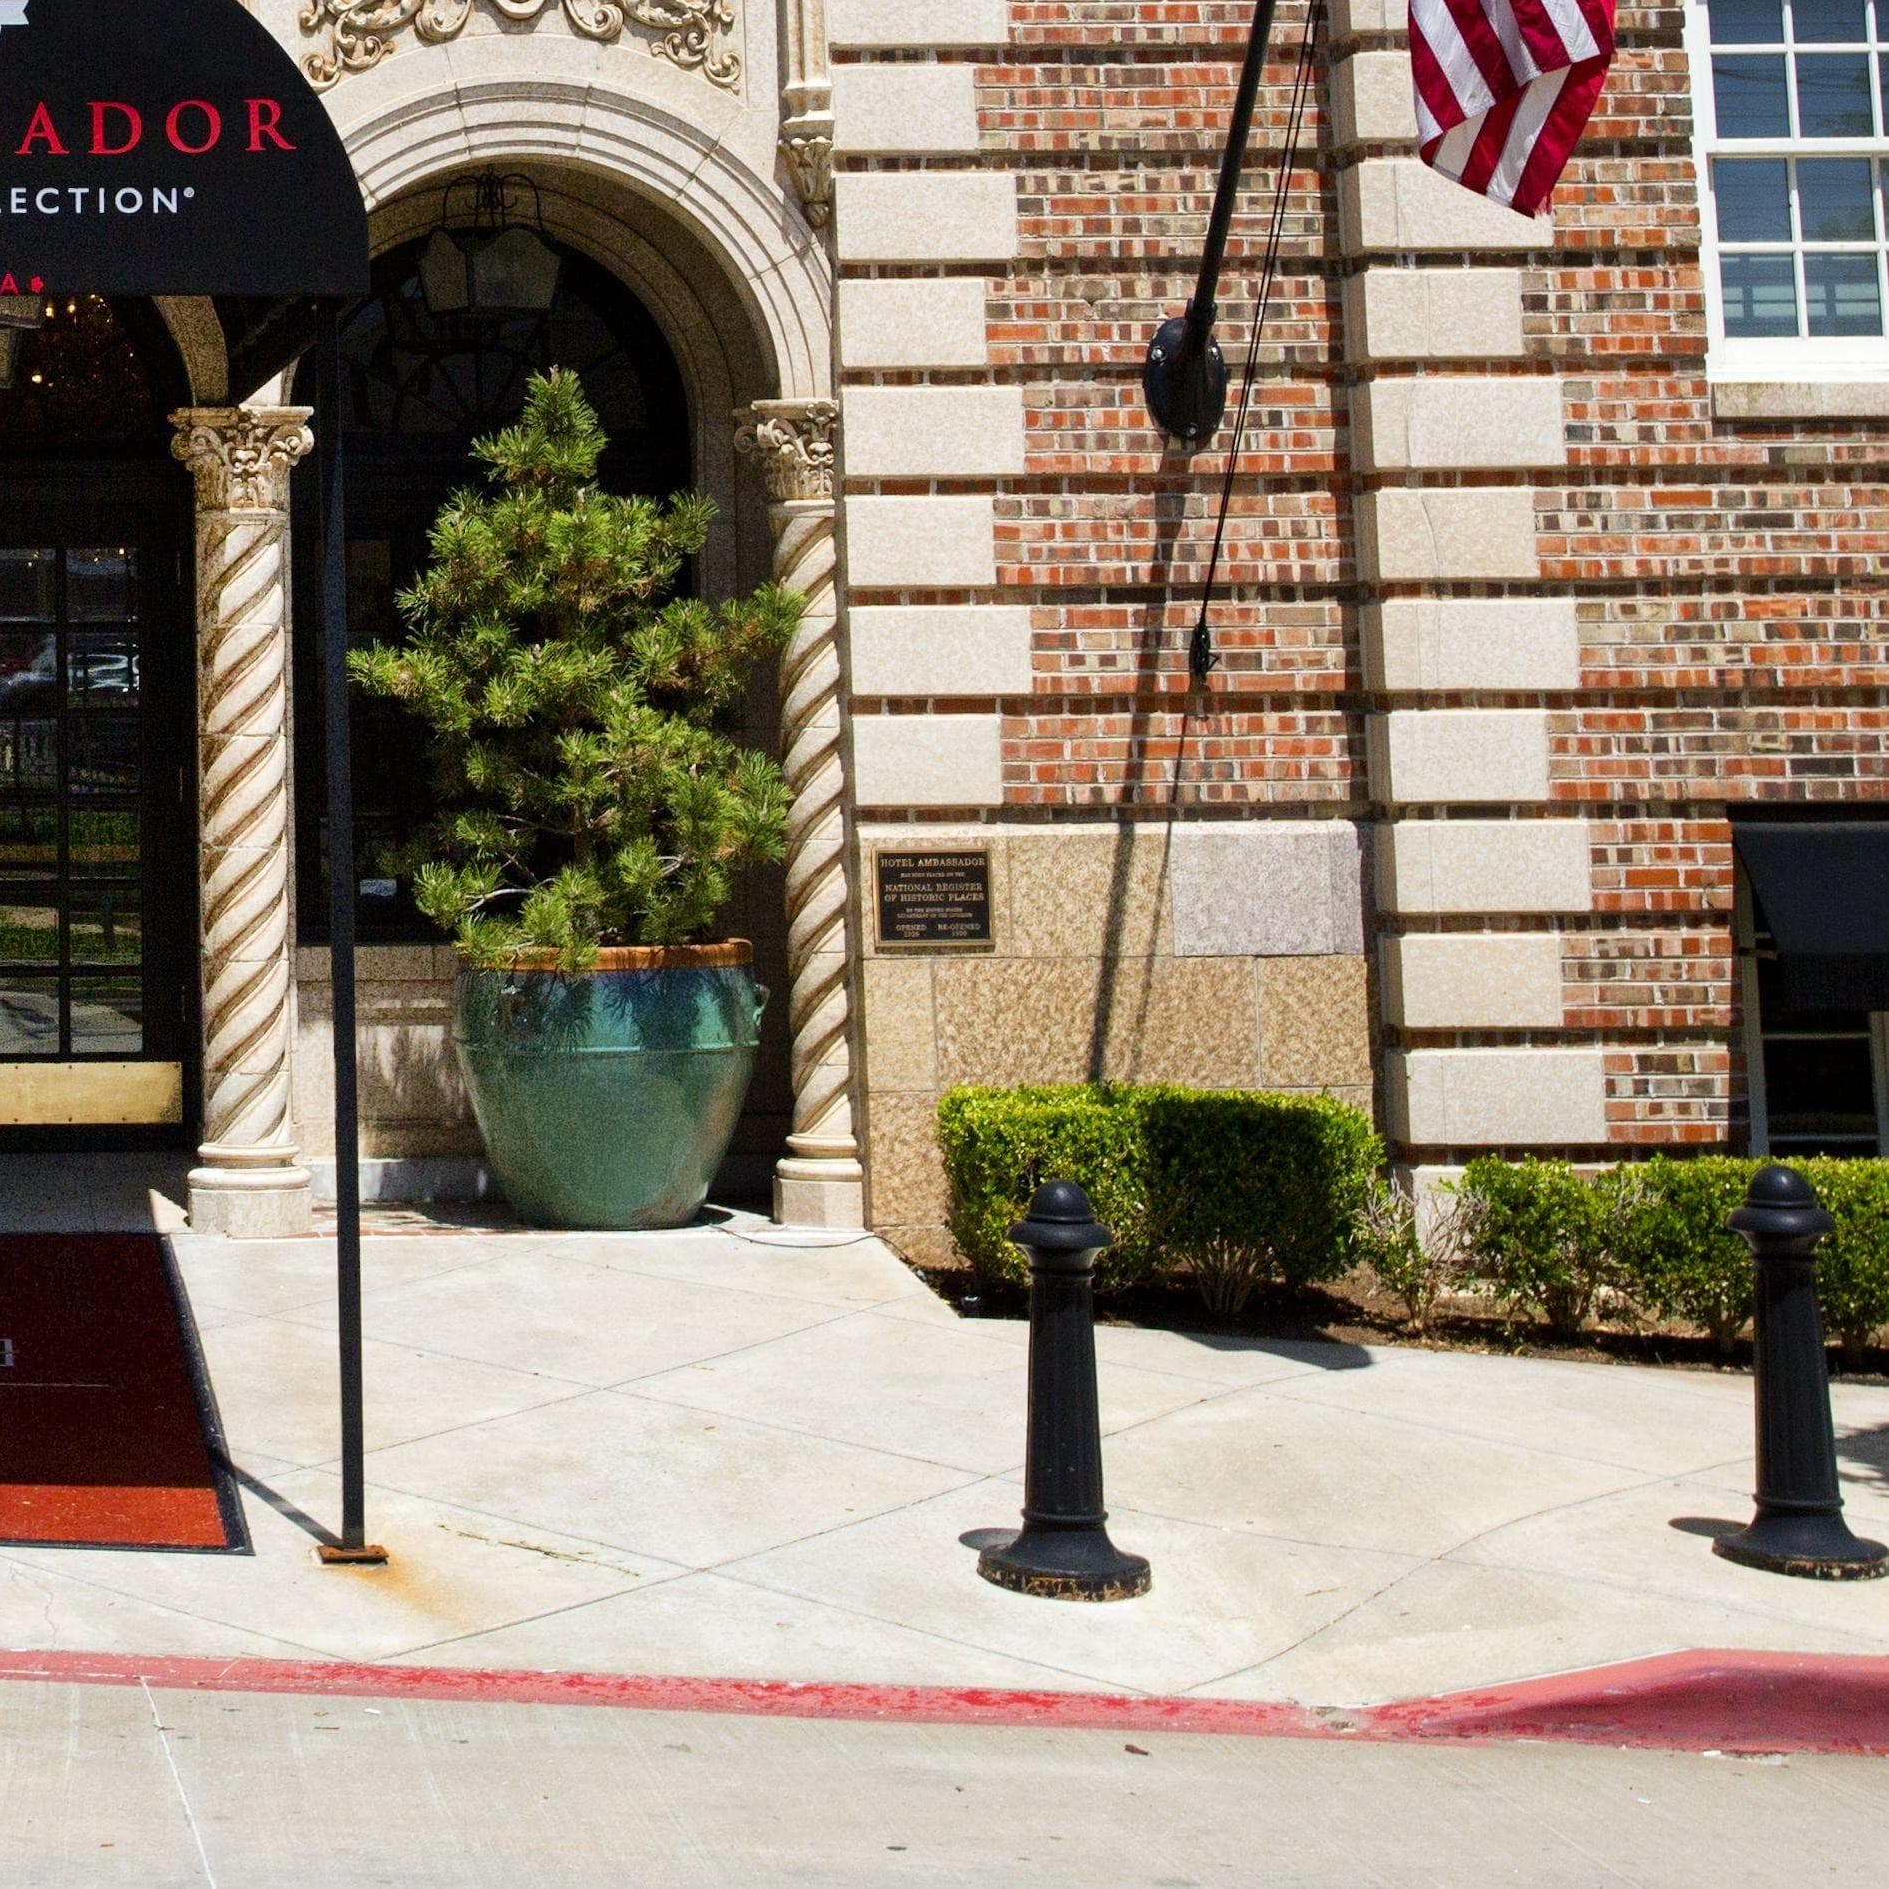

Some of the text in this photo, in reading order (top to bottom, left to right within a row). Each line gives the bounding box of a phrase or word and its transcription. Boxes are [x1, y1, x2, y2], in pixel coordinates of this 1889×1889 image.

[880, 858, 985, 867] HOTEL AMBASSADOR
[885, 882, 983, 892] NATIONAL REGISTER
[884, 892, 984, 902] OF HISTORIC PLACES
